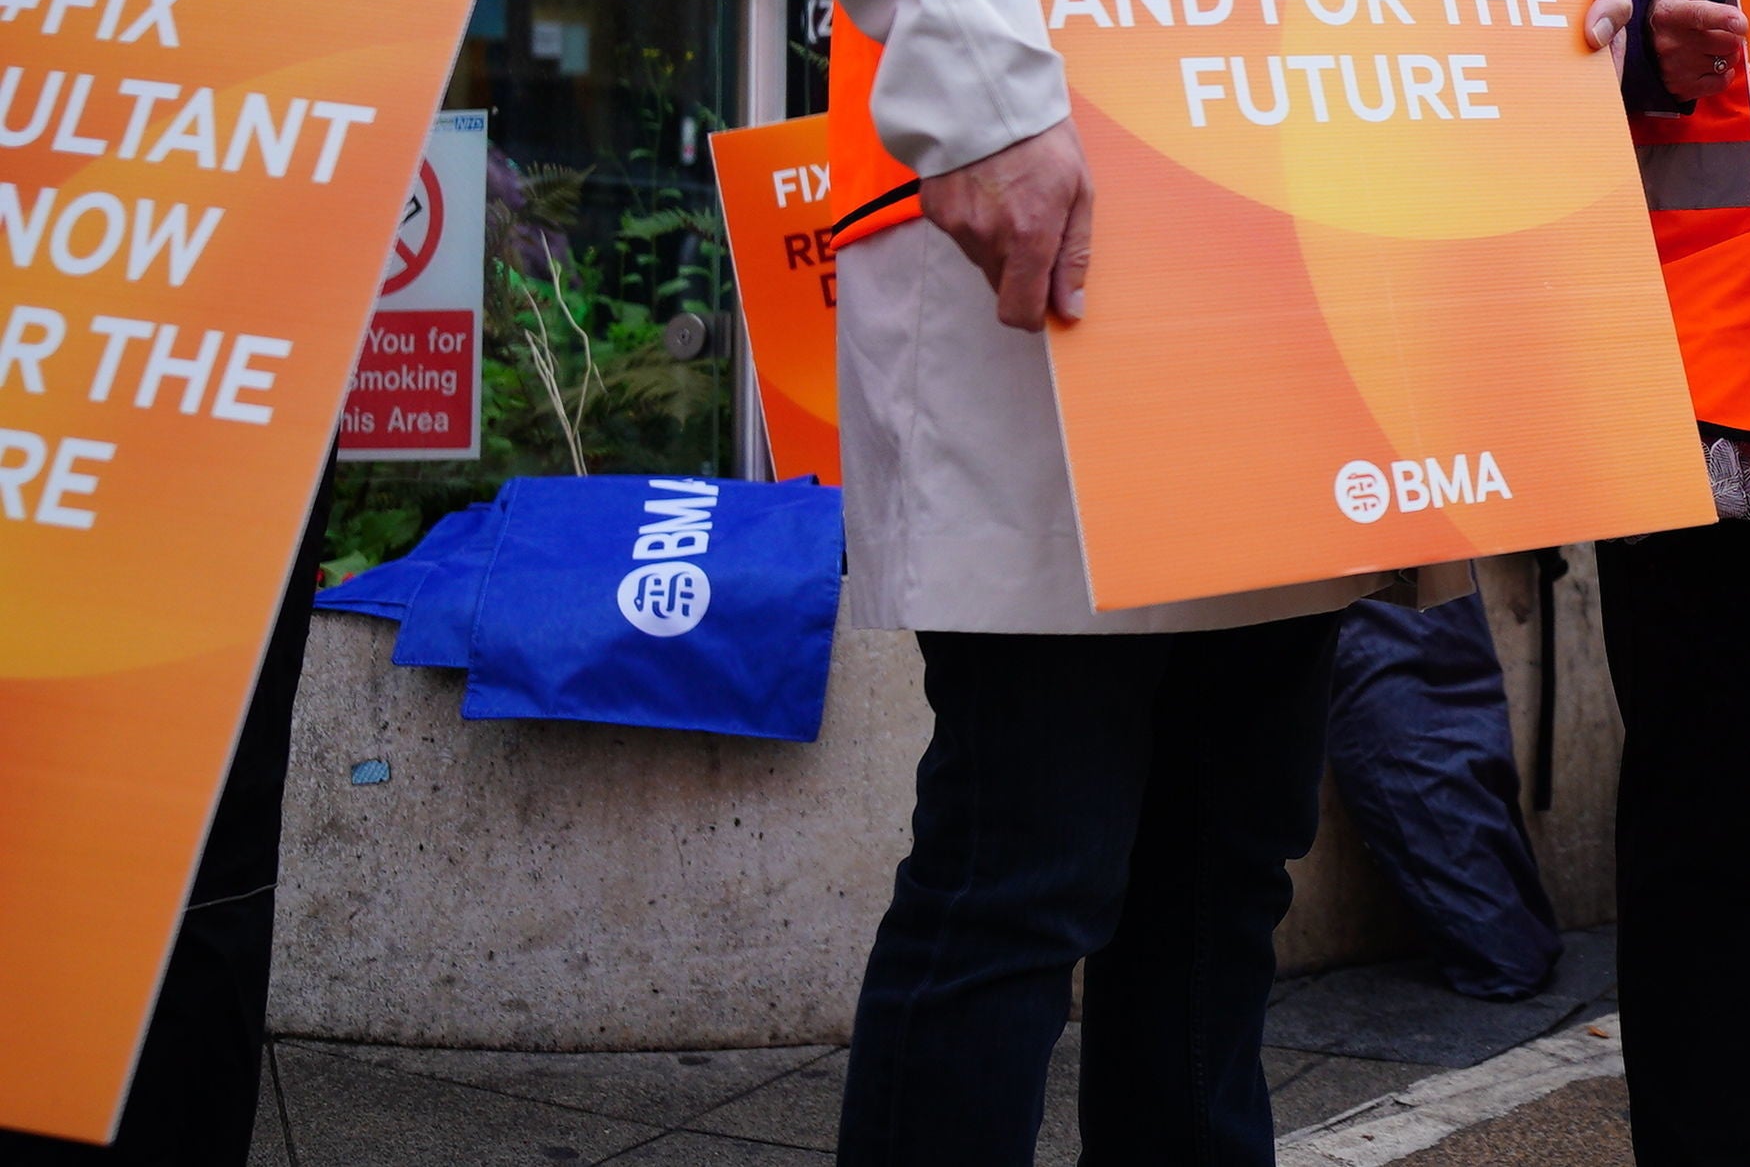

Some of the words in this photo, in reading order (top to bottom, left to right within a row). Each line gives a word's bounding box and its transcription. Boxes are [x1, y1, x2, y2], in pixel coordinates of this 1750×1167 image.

[1179, 54, 1500, 128] FUTURE
[772, 162, 831, 208] FIX
[0, 183, 226, 288] NOW
[89, 315, 294, 425] THE
[369, 328, 415, 354] You
[428, 327, 466, 353] for
[387, 406, 449, 433] Area
[1390, 451, 1513, 513] BMA
